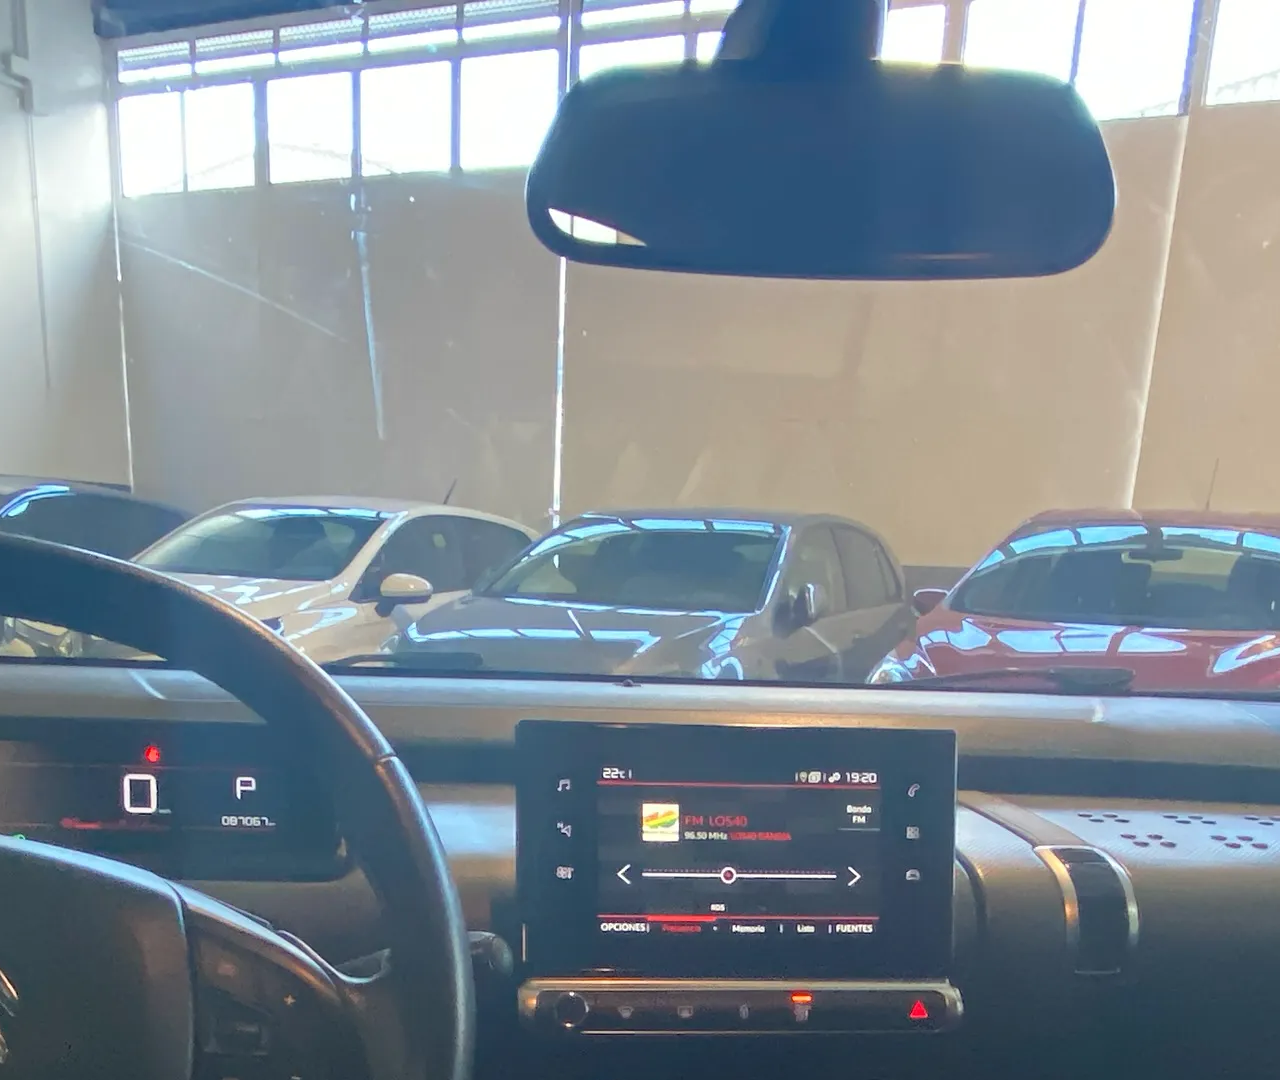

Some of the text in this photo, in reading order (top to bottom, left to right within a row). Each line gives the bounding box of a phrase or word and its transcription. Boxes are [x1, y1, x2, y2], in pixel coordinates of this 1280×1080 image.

[845, 772, 877, 783] 19:20
[236, 776, 256, 800] P
[123, 774, 157, 813] 0
[684, 815, 703, 826] FM
[852, 815, 866, 824] FM
[708, 831, 728, 841] MHz
[600, 922, 646, 932] OPCIONES
[835, 924, 874, 933] FUENTES
